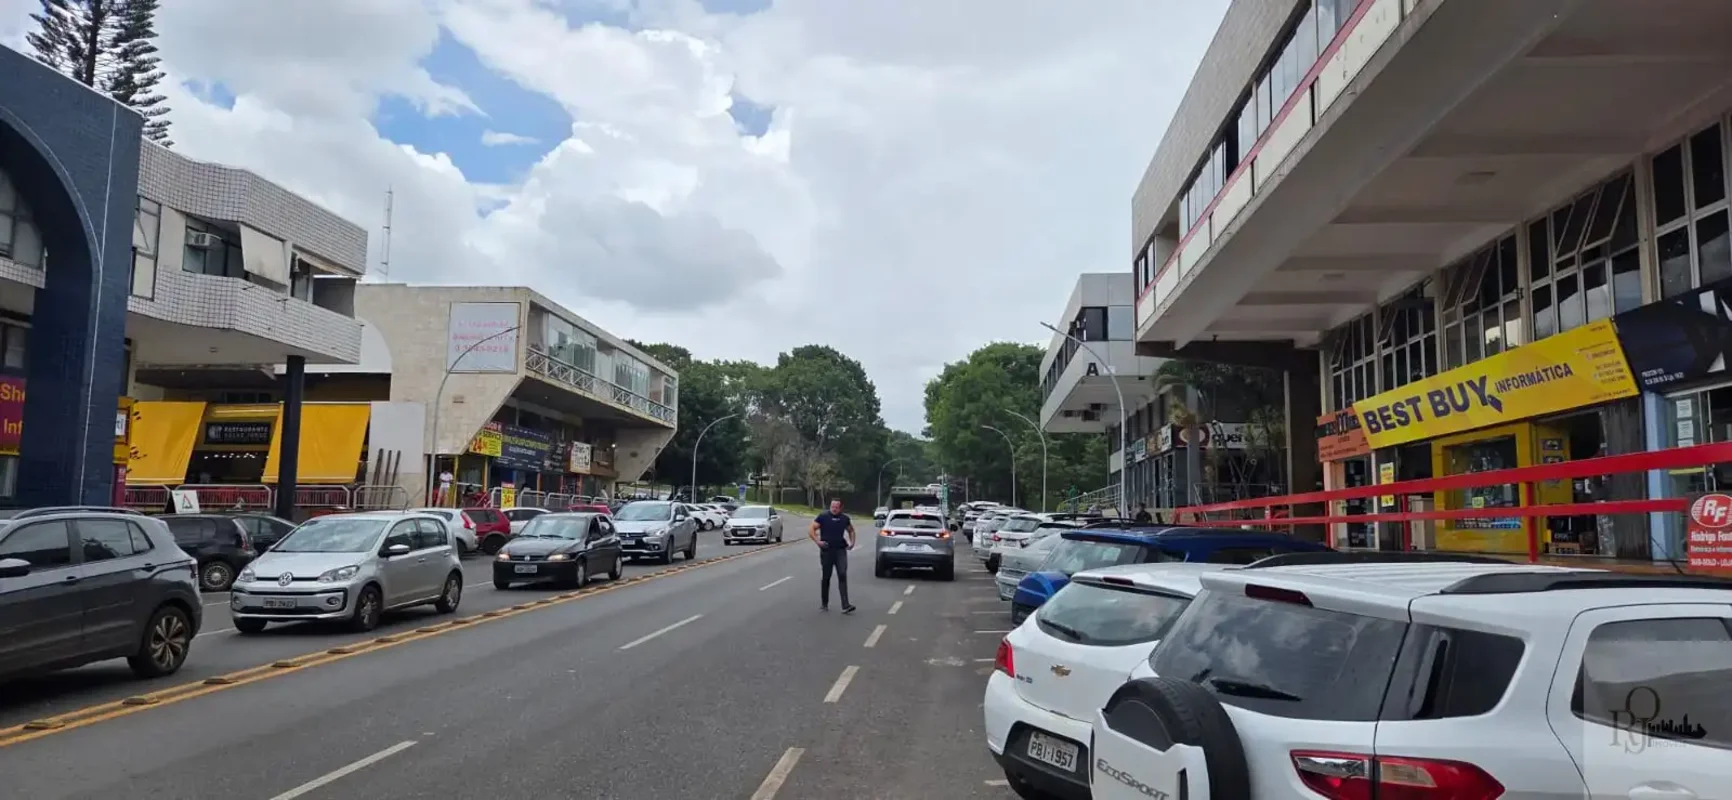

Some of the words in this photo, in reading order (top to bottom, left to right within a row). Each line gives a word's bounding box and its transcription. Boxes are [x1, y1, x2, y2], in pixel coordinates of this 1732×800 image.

[1362, 396, 1424, 434] BEST
[1427, 375, 1488, 418] BUY
[1495, 363, 1573, 394] INFORMÁTICA
[1703, 499, 1728, 523] RF
